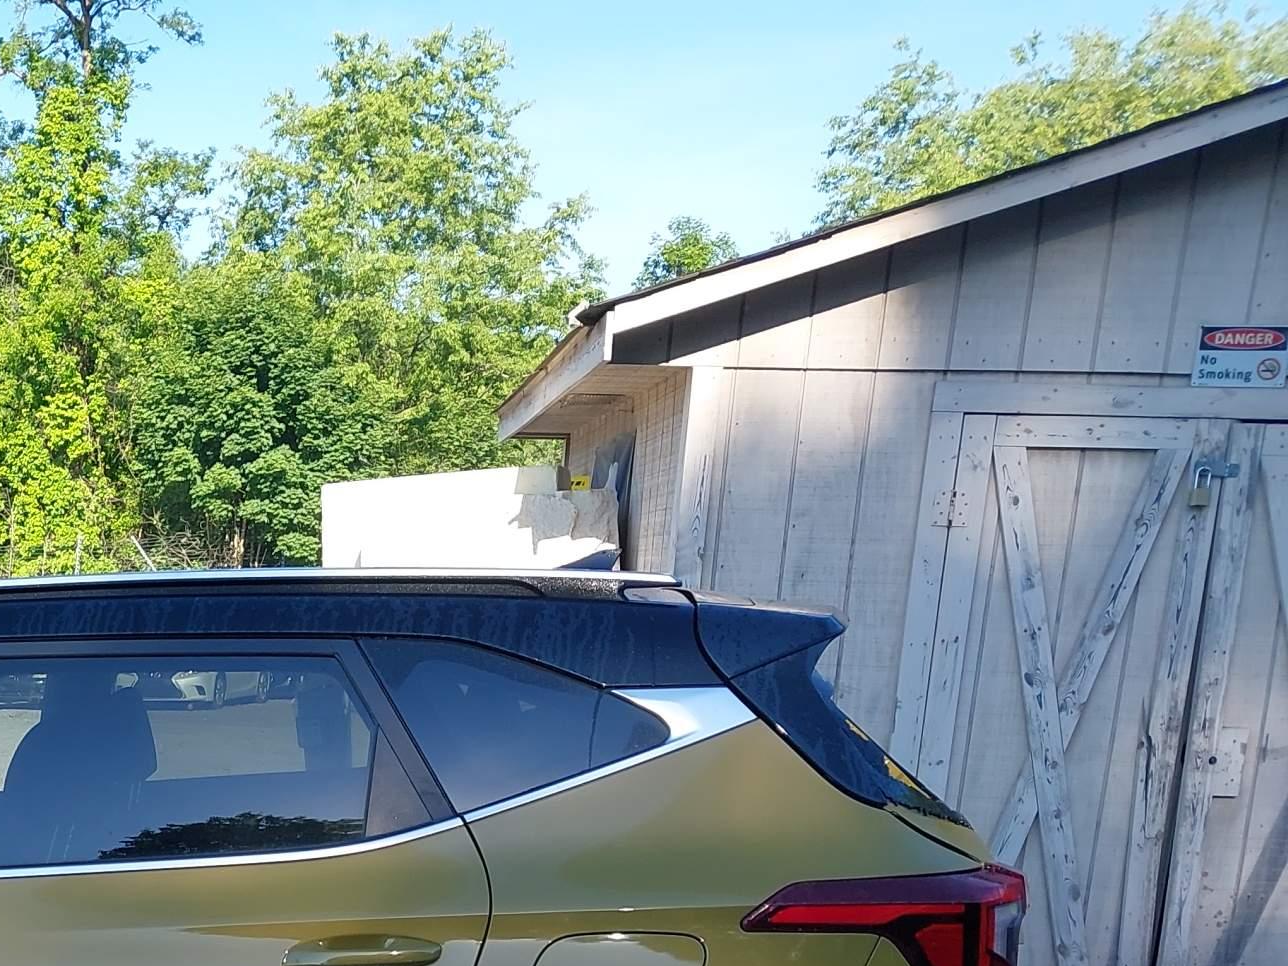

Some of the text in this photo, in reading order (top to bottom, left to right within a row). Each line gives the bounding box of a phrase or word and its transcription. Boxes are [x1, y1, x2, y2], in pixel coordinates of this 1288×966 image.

[1215, 333, 1274, 345] DANGER
[1200, 355, 1216, 365] No
[1198, 369, 1252, 383] Smoking
